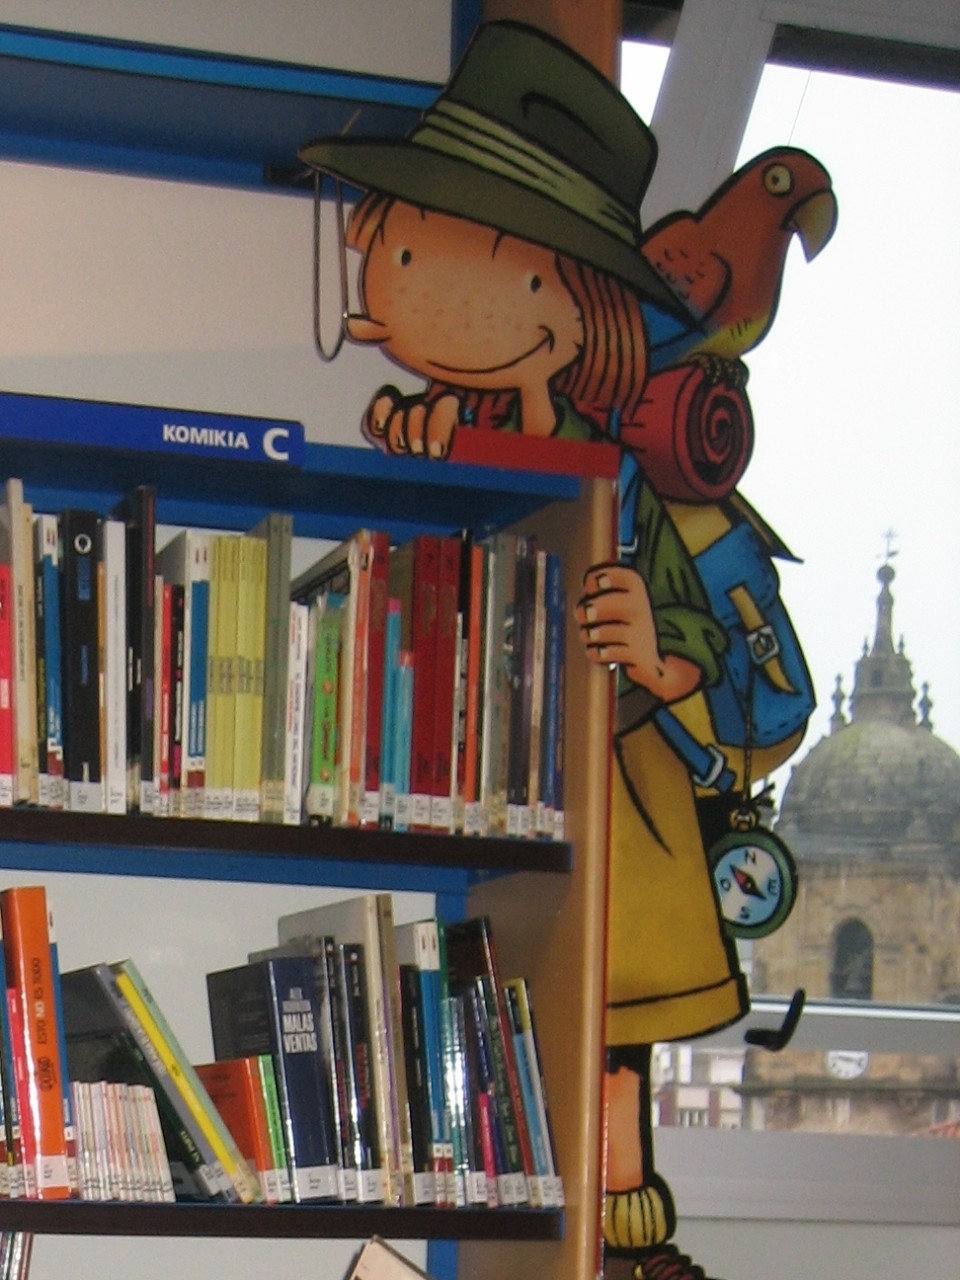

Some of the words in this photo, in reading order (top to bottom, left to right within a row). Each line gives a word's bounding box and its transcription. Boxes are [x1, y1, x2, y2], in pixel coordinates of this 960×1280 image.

[162, 424, 250, 450] KOMIKIA
[262, 427, 290, 461] C
[745, 850, 756, 864] N
[36, 1001, 46, 1019] NO
[283, 1013, 314, 1033] MALAS
[284, 1033, 318, 1053] VENTAS
